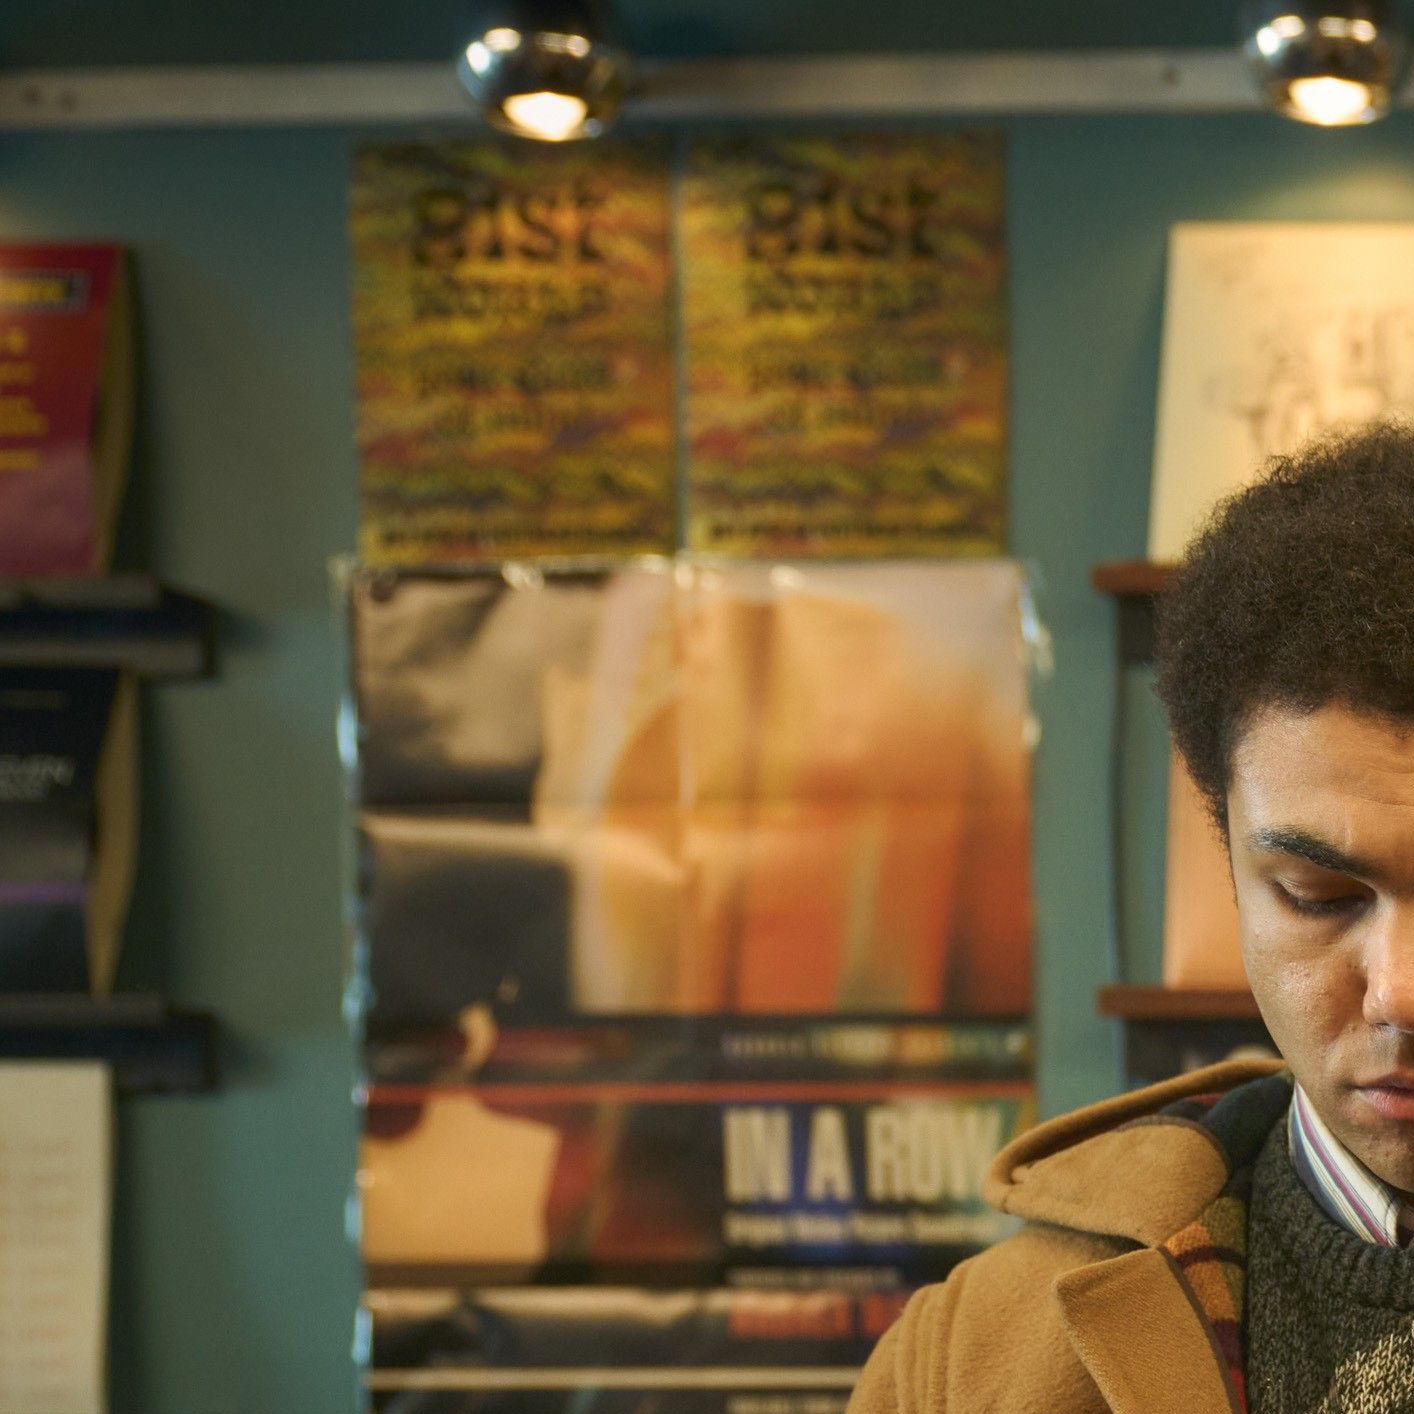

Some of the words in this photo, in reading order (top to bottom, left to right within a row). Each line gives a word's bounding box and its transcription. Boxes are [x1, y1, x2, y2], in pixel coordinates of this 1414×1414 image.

[722, 1106, 793, 1204] IN
[803, 1106, 855, 1204] A
[864, 1104, 1002, 1204] ROW
